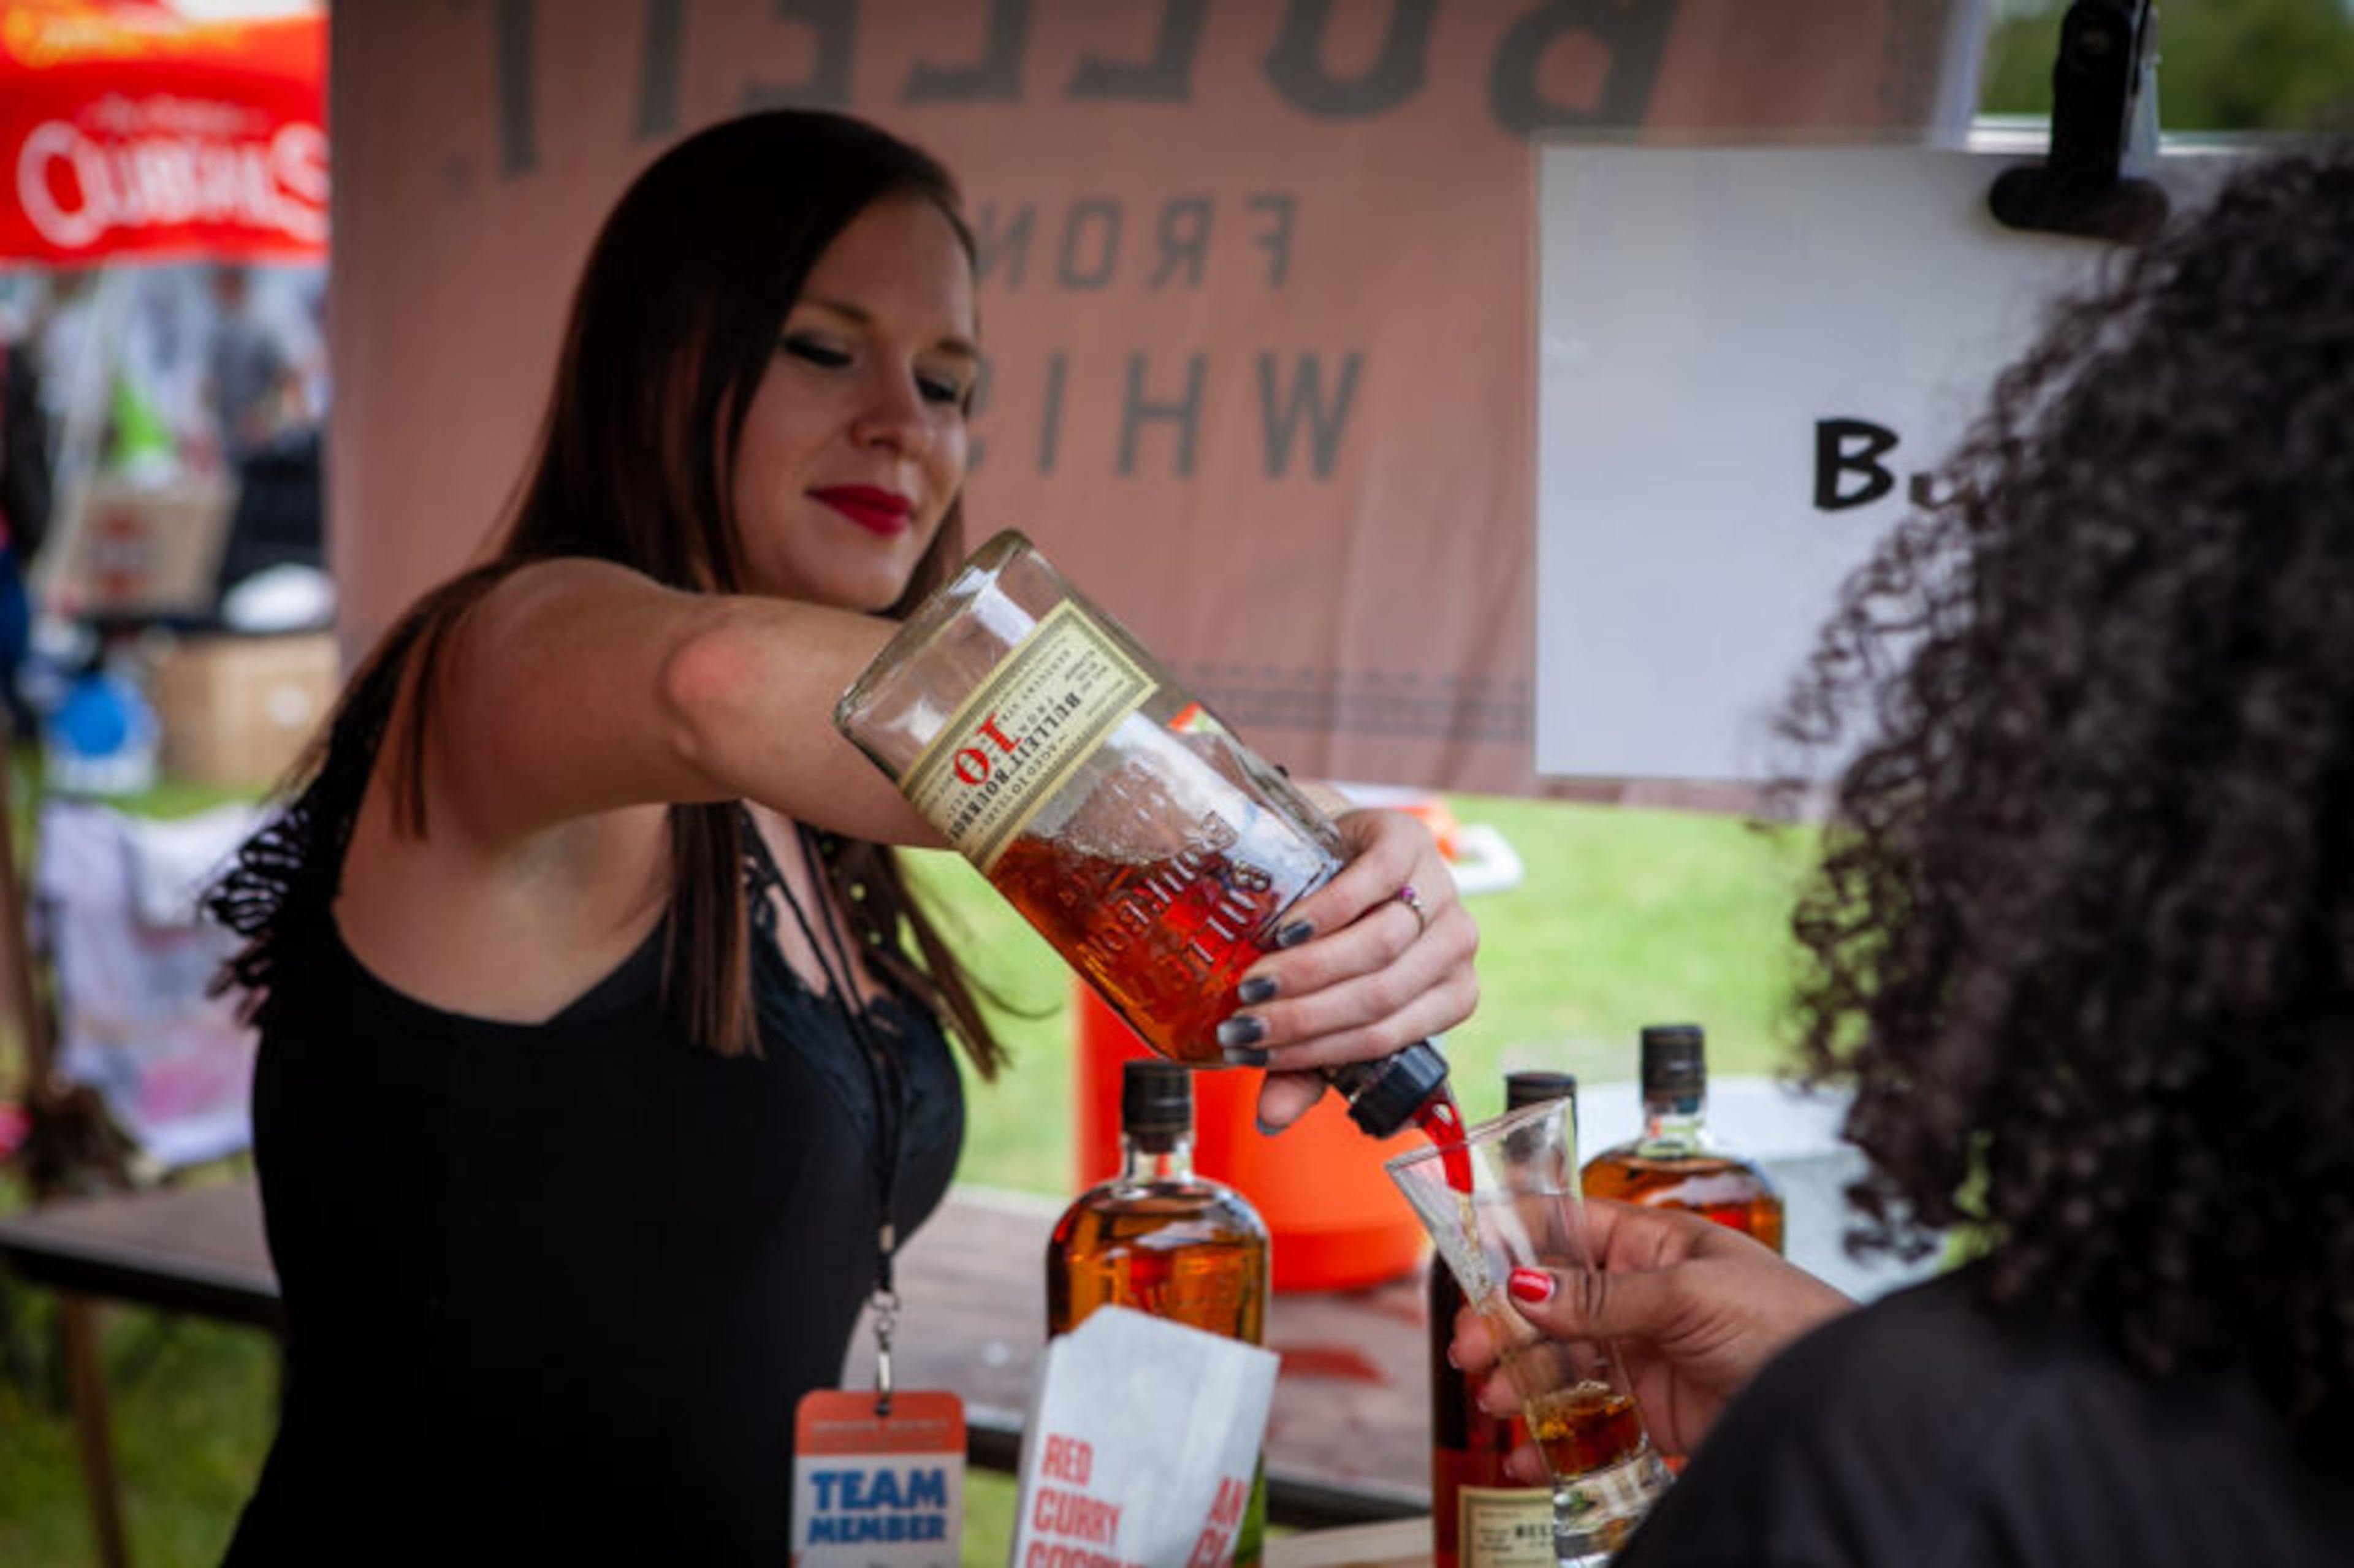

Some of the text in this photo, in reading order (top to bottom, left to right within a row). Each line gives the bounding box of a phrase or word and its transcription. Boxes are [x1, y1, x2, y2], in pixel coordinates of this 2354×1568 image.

[953, 711, 1024, 782] 10
[1007, 691, 1082, 769] BULLEIT
[1043, 1433, 1093, 1486] RED
[809, 1467, 948, 1510] TEAM
[1034, 1486, 1122, 1547] CURRY
[806, 1513, 947, 1546] MEMBER
